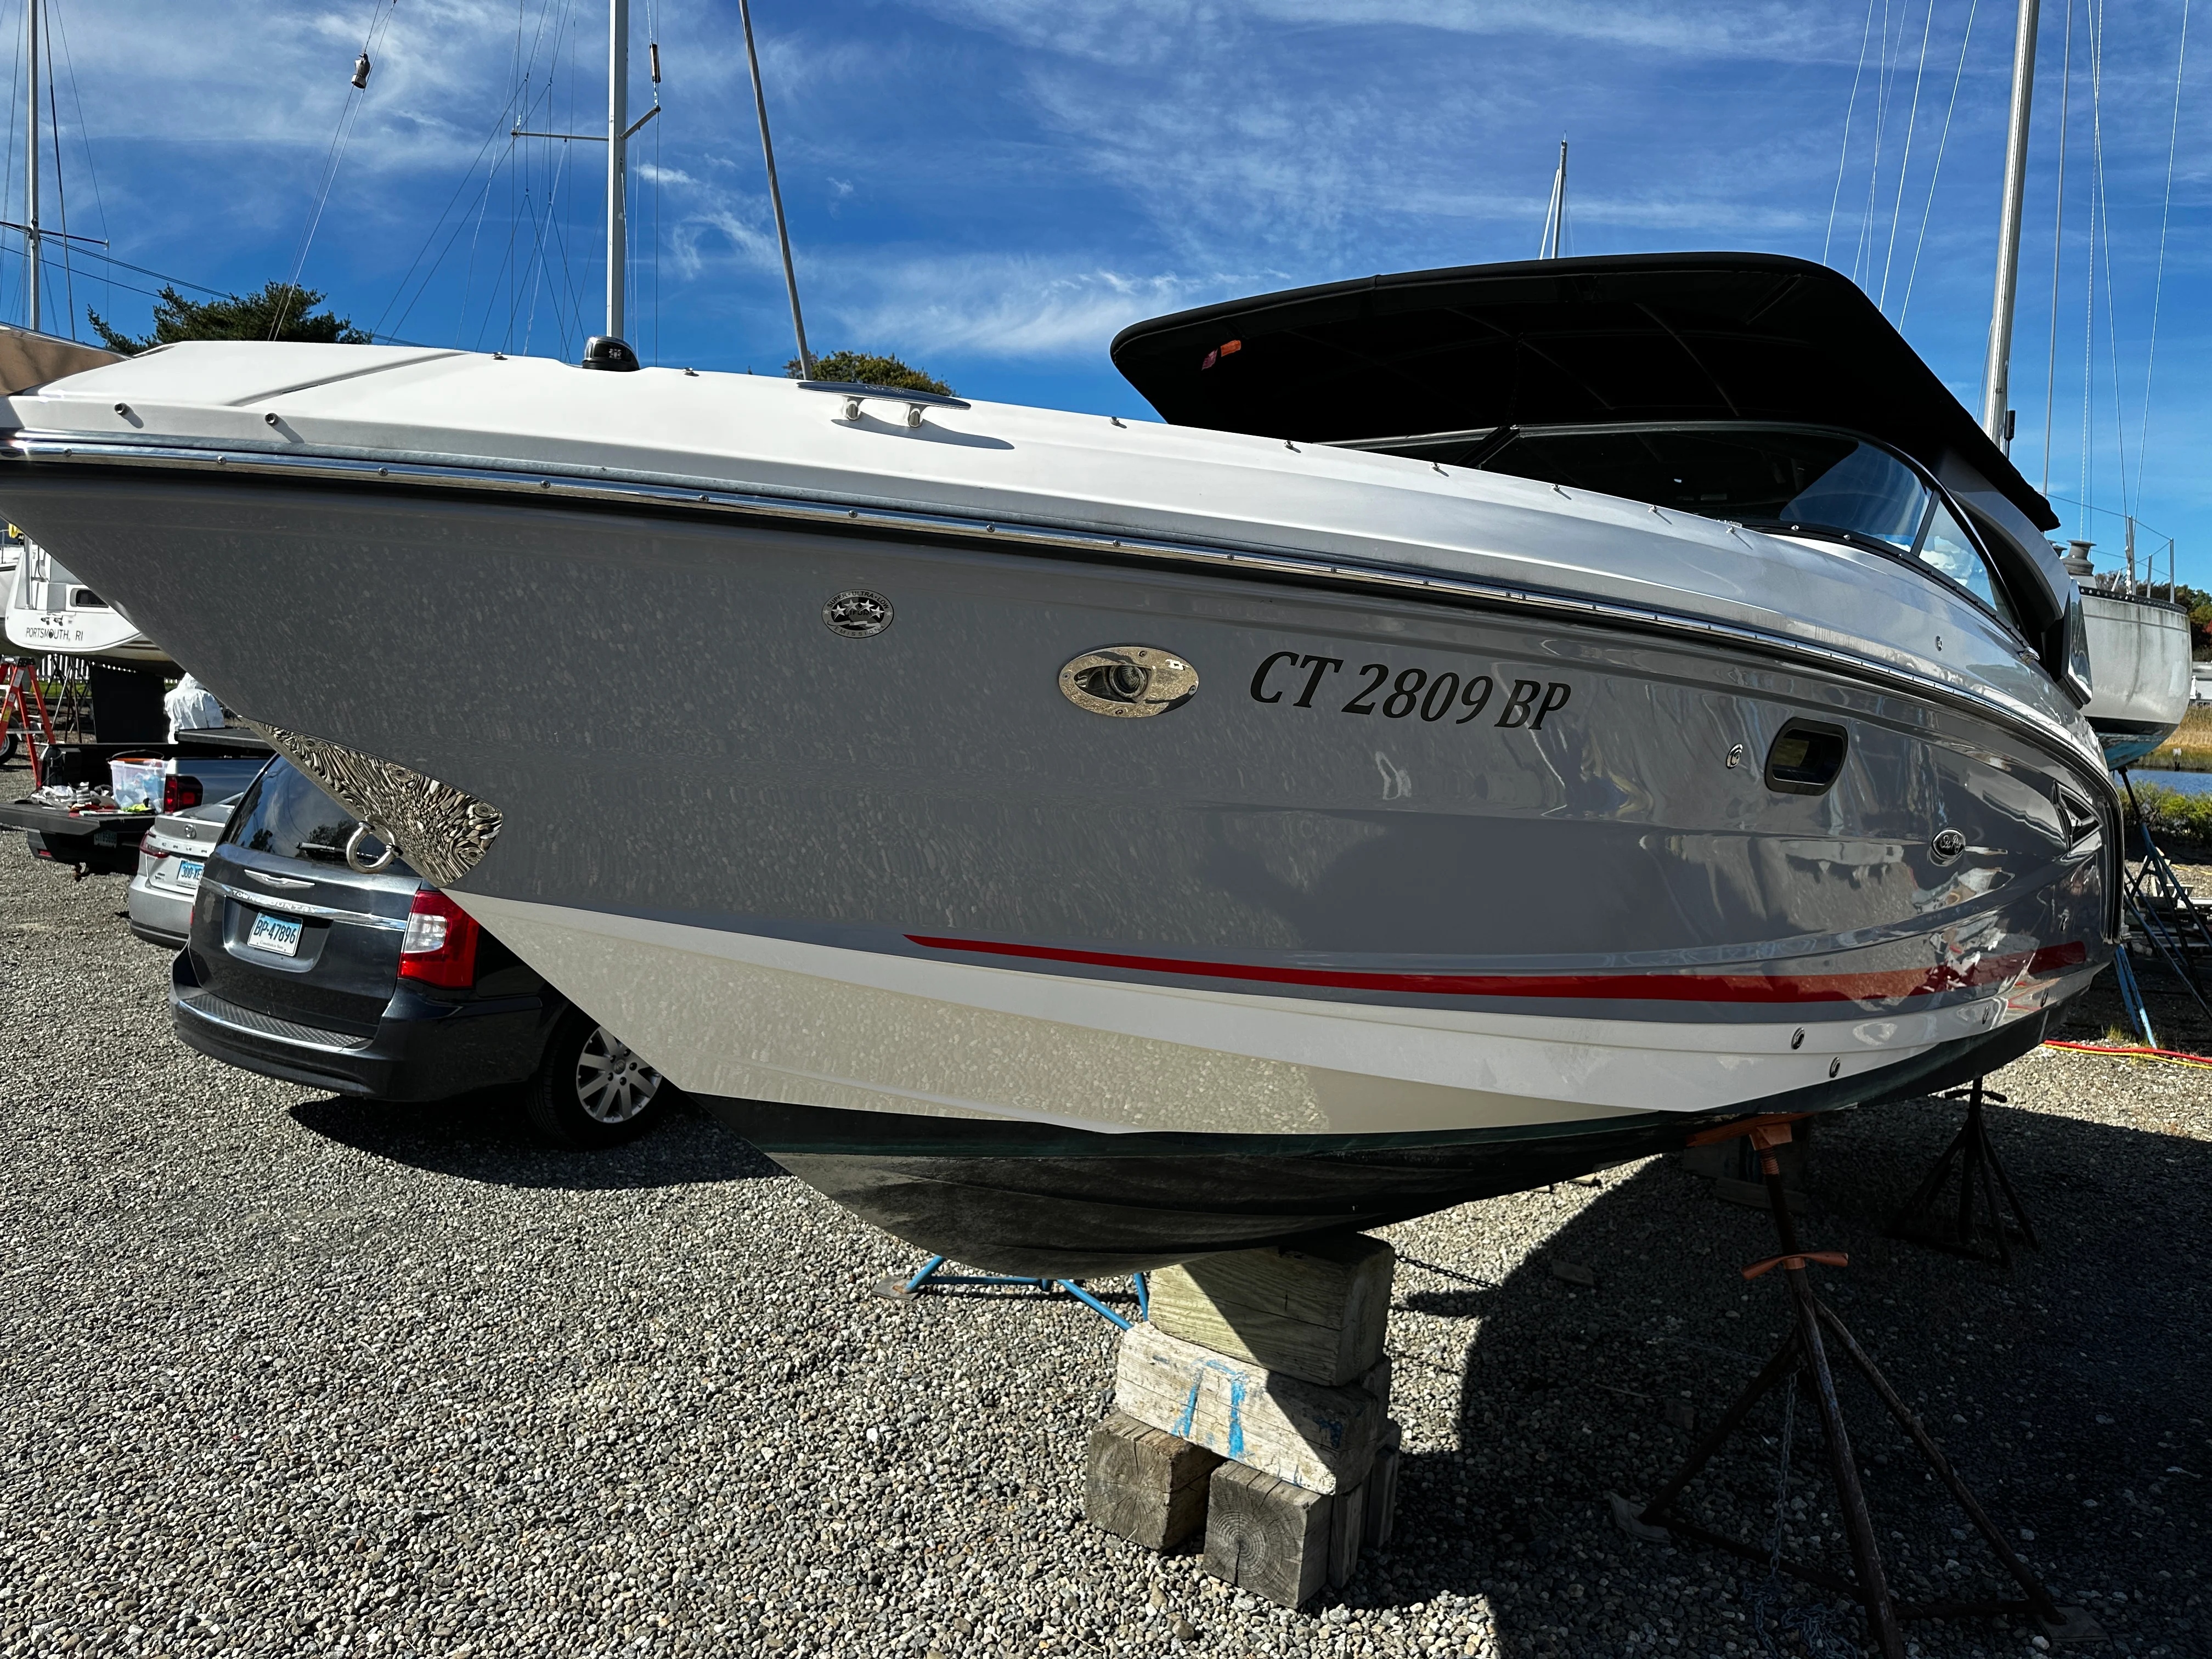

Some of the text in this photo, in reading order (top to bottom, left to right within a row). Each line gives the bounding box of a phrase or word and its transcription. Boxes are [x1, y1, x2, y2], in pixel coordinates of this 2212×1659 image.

[827, 590, 889, 610] SUPER ULTRA LOW
[75, 630, 83, 641] RI
[833, 625, 881, 636] EMISSION
[1250, 651, 1572, 730] CT 2809 BP
